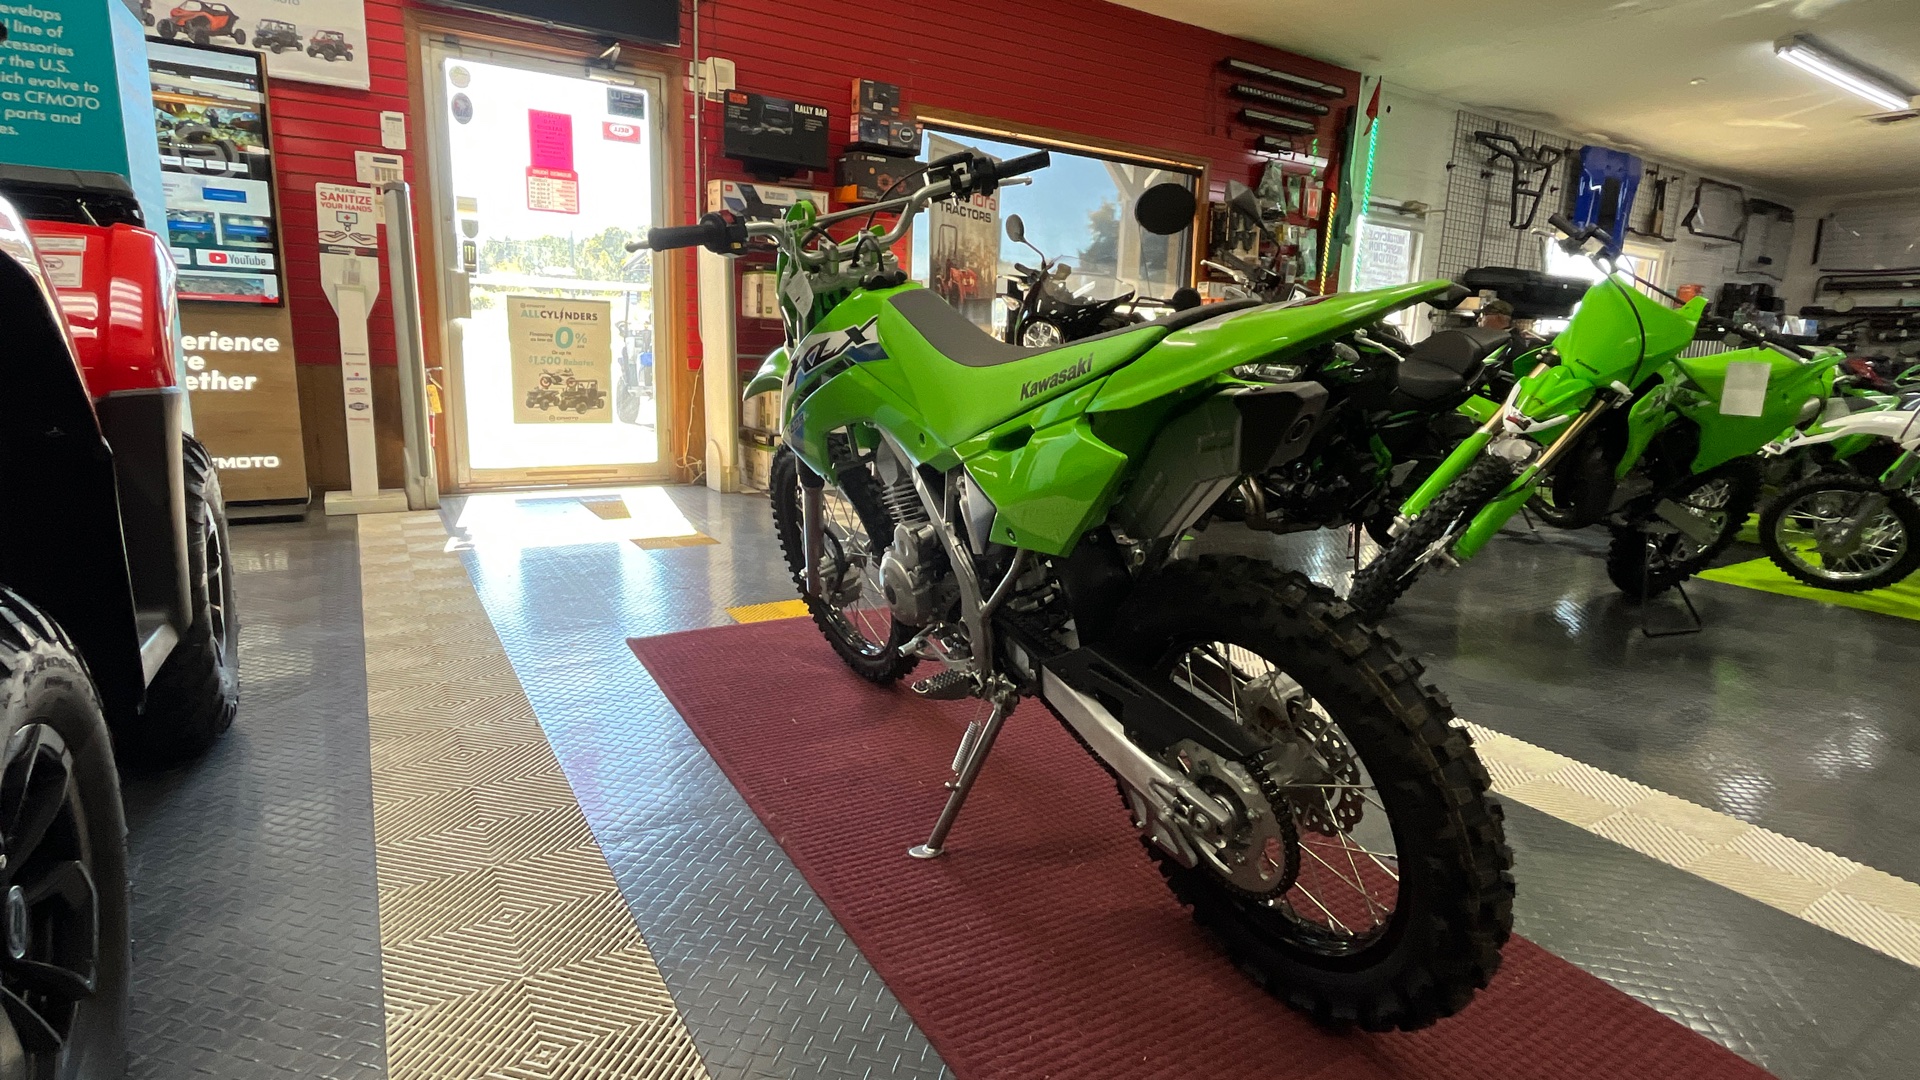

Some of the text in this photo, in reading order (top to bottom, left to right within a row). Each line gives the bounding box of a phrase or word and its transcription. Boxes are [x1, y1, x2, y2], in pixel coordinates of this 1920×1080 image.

[13, 19, 43, 36] line
[46, 25, 64, 38] of
[0, 40, 74, 57] cessories
[9, 54, 35, 69] the
[39, 58, 71, 74] U.S.
[28, 77, 79, 92] evolve
[83, 81, 99, 94] to
[2, 90, 100, 110] as CFMOTO
[4, 108, 82, 125] parts and
[794, 103, 828, 118] RALLY BAR
[320, 191, 372, 205] SANITIZE
[320, 201, 372, 212] YOUR HANDS
[940, 201, 992, 223] TRACTORS
[228, 254, 266, 266] YouTube
[180, 330, 280, 352] erience
[185, 369, 258, 391] ether
[1020, 352, 1094, 401] Kawasaki
